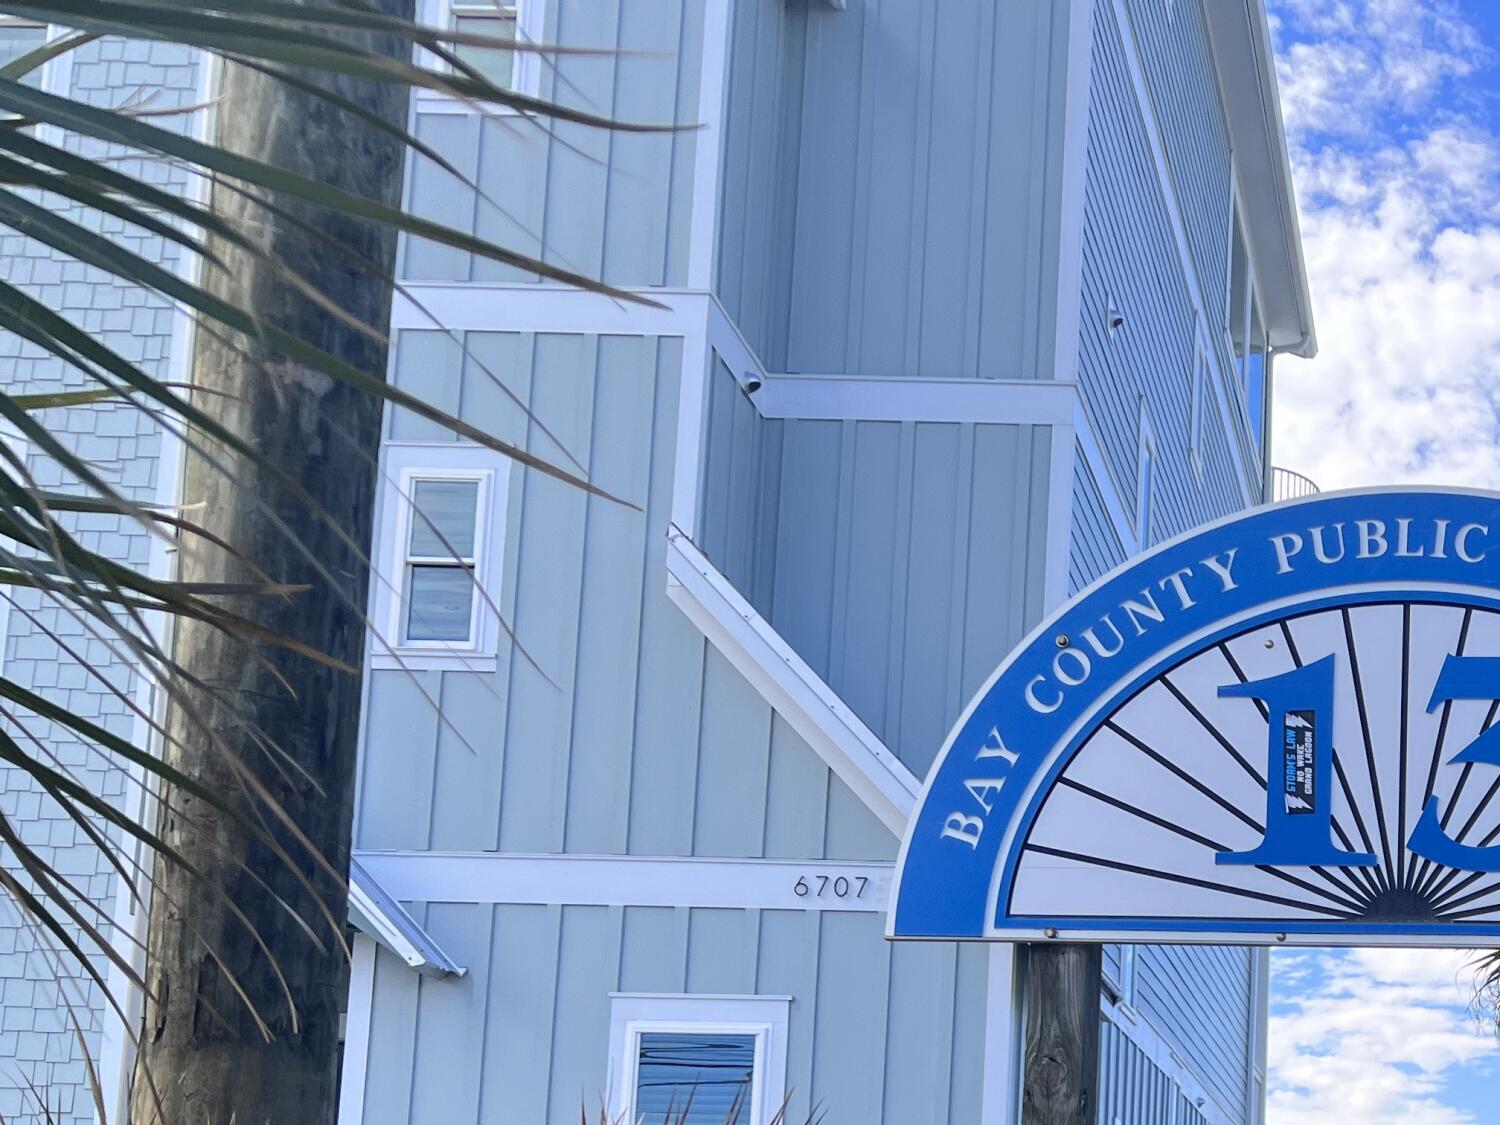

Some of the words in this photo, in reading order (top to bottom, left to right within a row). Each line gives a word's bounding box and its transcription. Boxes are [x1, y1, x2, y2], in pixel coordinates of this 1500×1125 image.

[942, 743, 1022, 852] BAY
[1023, 549, 1241, 716] COUNTY
[1270, 517, 1491, 575] PUBLIC
[1286, 729, 1297, 750] LAW
[1304, 731, 1313, 764] LAGOON
[1296, 744, 1305, 768] WAKE
[1296, 770, 1305, 783] NO
[1304, 767, 1313, 795] GRAND
[794, 875, 869, 898] 6707
